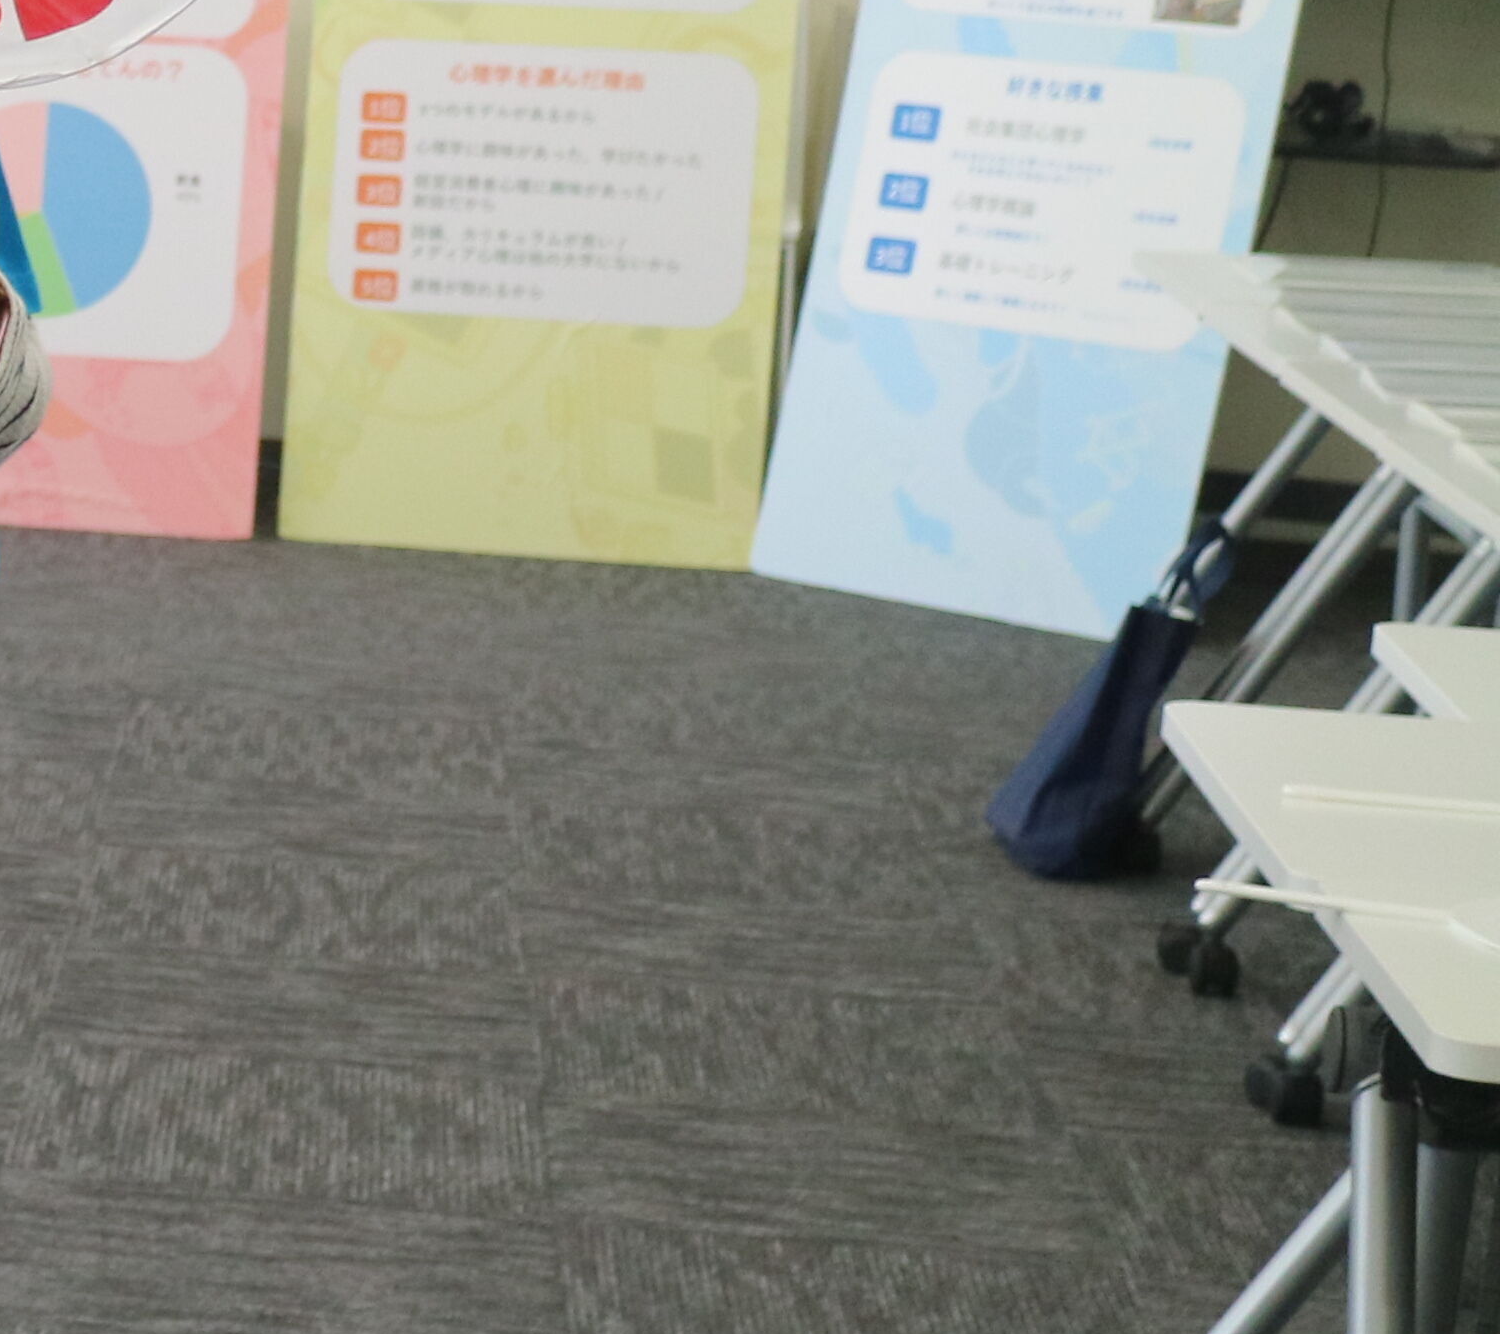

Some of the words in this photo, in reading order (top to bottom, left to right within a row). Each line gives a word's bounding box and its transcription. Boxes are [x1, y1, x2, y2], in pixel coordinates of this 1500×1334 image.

[449, 63, 645, 92] 心理学を選んだ理由
